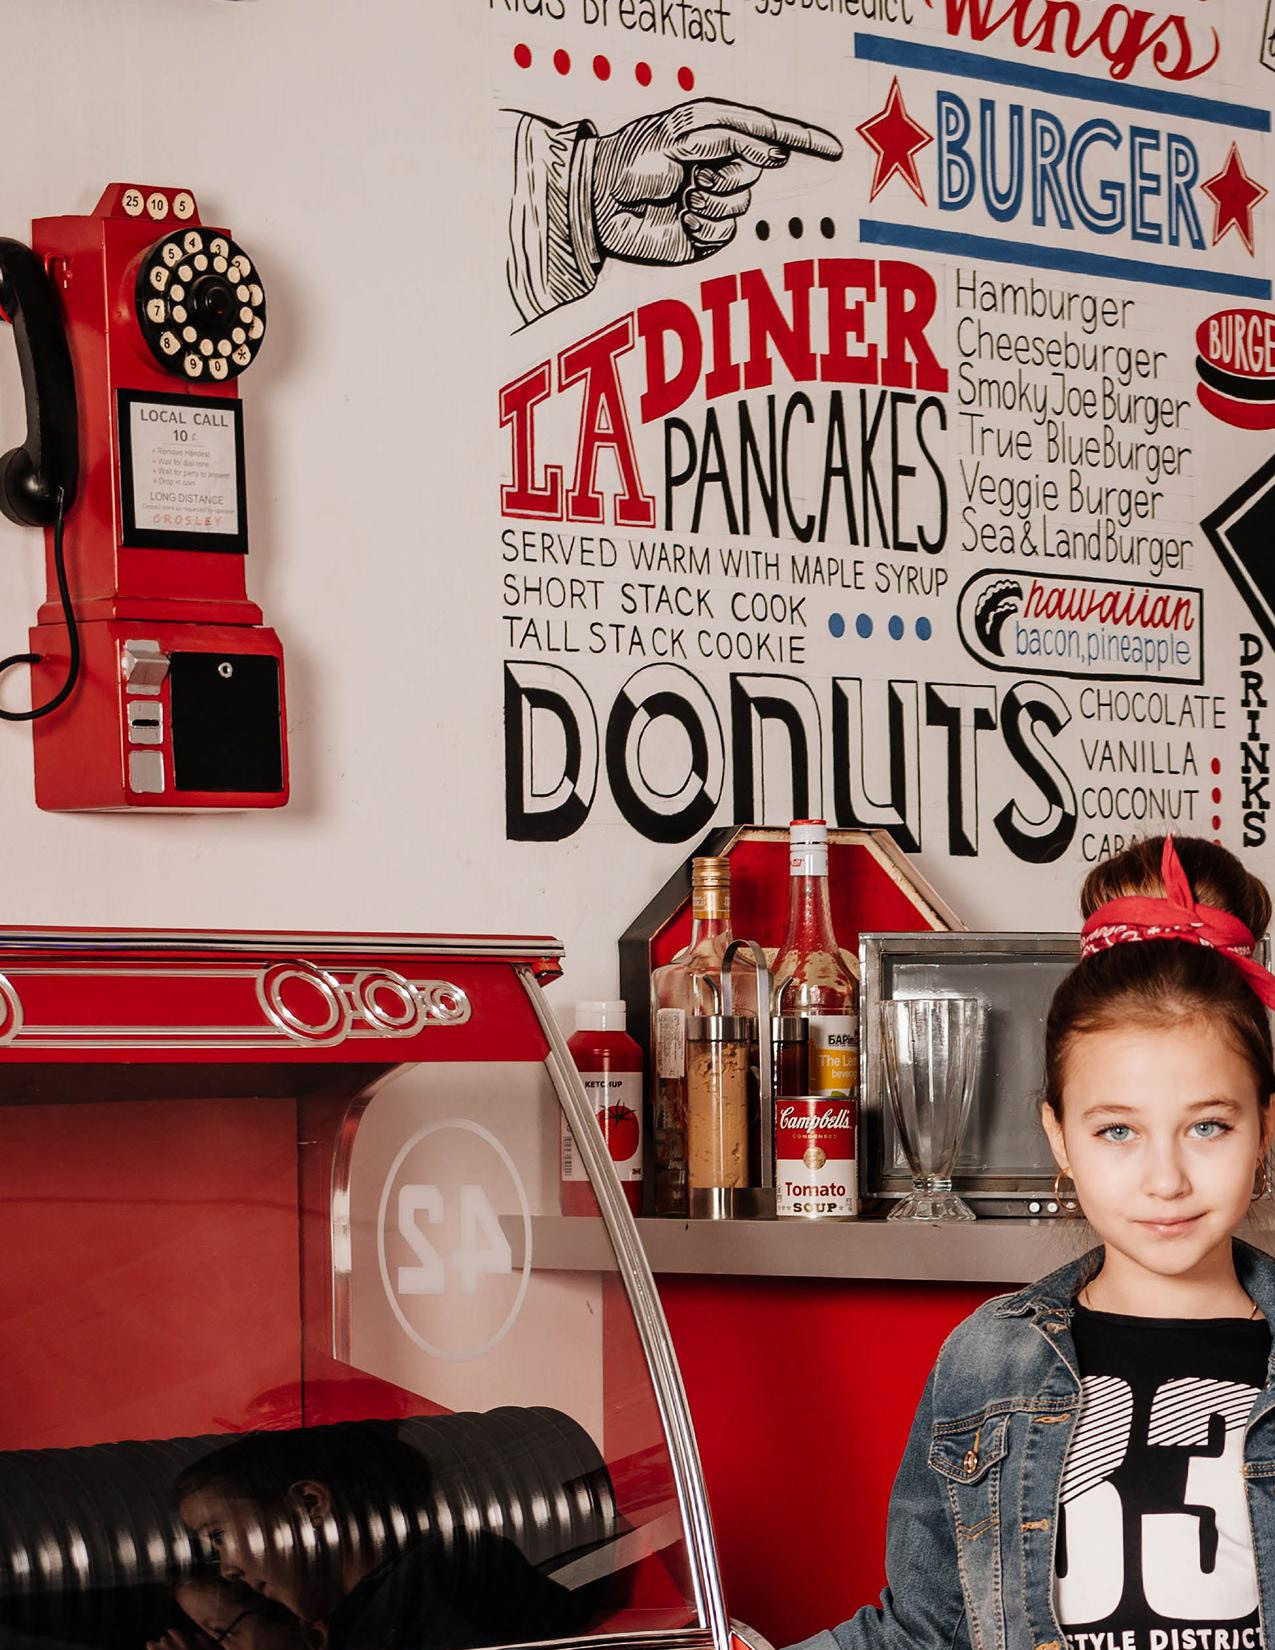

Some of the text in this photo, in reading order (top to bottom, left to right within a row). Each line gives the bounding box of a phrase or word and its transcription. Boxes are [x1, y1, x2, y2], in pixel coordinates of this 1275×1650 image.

[936, 90, 1207, 251] BURGER
[126, 194, 186, 213] 25 10 5
[168, 248, 175, 260] 5
[188, 237, 196, 248] 4
[155, 271, 162, 282] 6
[154, 305, 161, 316] 7
[956, 267, 1135, 335] Hamburger
[163, 337, 171, 349] 8
[638, 257, 950, 424] DINER
[957, 316, 1168, 386] Cheeseburger
[190, 358, 197, 370] 9
[140, 408, 229, 428] LOCAL CALL
[172, 429, 188, 442] 10
[499, 311, 656, 529] LA
[958, 411, 1033, 461] True
[664, 388, 949, 555] PANCAKES
[150, 491, 225, 505] LONG DISTANCE
[960, 459, 1165, 528] Veggie Burger
[152, 513, 222, 527] CROSLEY
[501, 528, 949, 598] SERVED WARM WITH MAPLE SYRUP
[502, 572, 808, 628] SHORT STACK COOK
[1022, 578, 1196, 632] hawaiian
[502, 615, 806, 665] TALL STACK COOKIE
[1079, 687, 1227, 730] CHOCOLATE
[1080, 738, 1199, 777] VANILLA
[1238, 632, 1271, 849] DRINKS
[503, 658, 1078, 865] DONUTS
[1081, 786, 1200, 821] COCONUT
[818, 1054, 841, 1069] The
[779, 1105, 851, 1134] Campbell's
[784, 1181, 846, 1197] Tomato
[792, 1202, 838, 1213] SOUP
